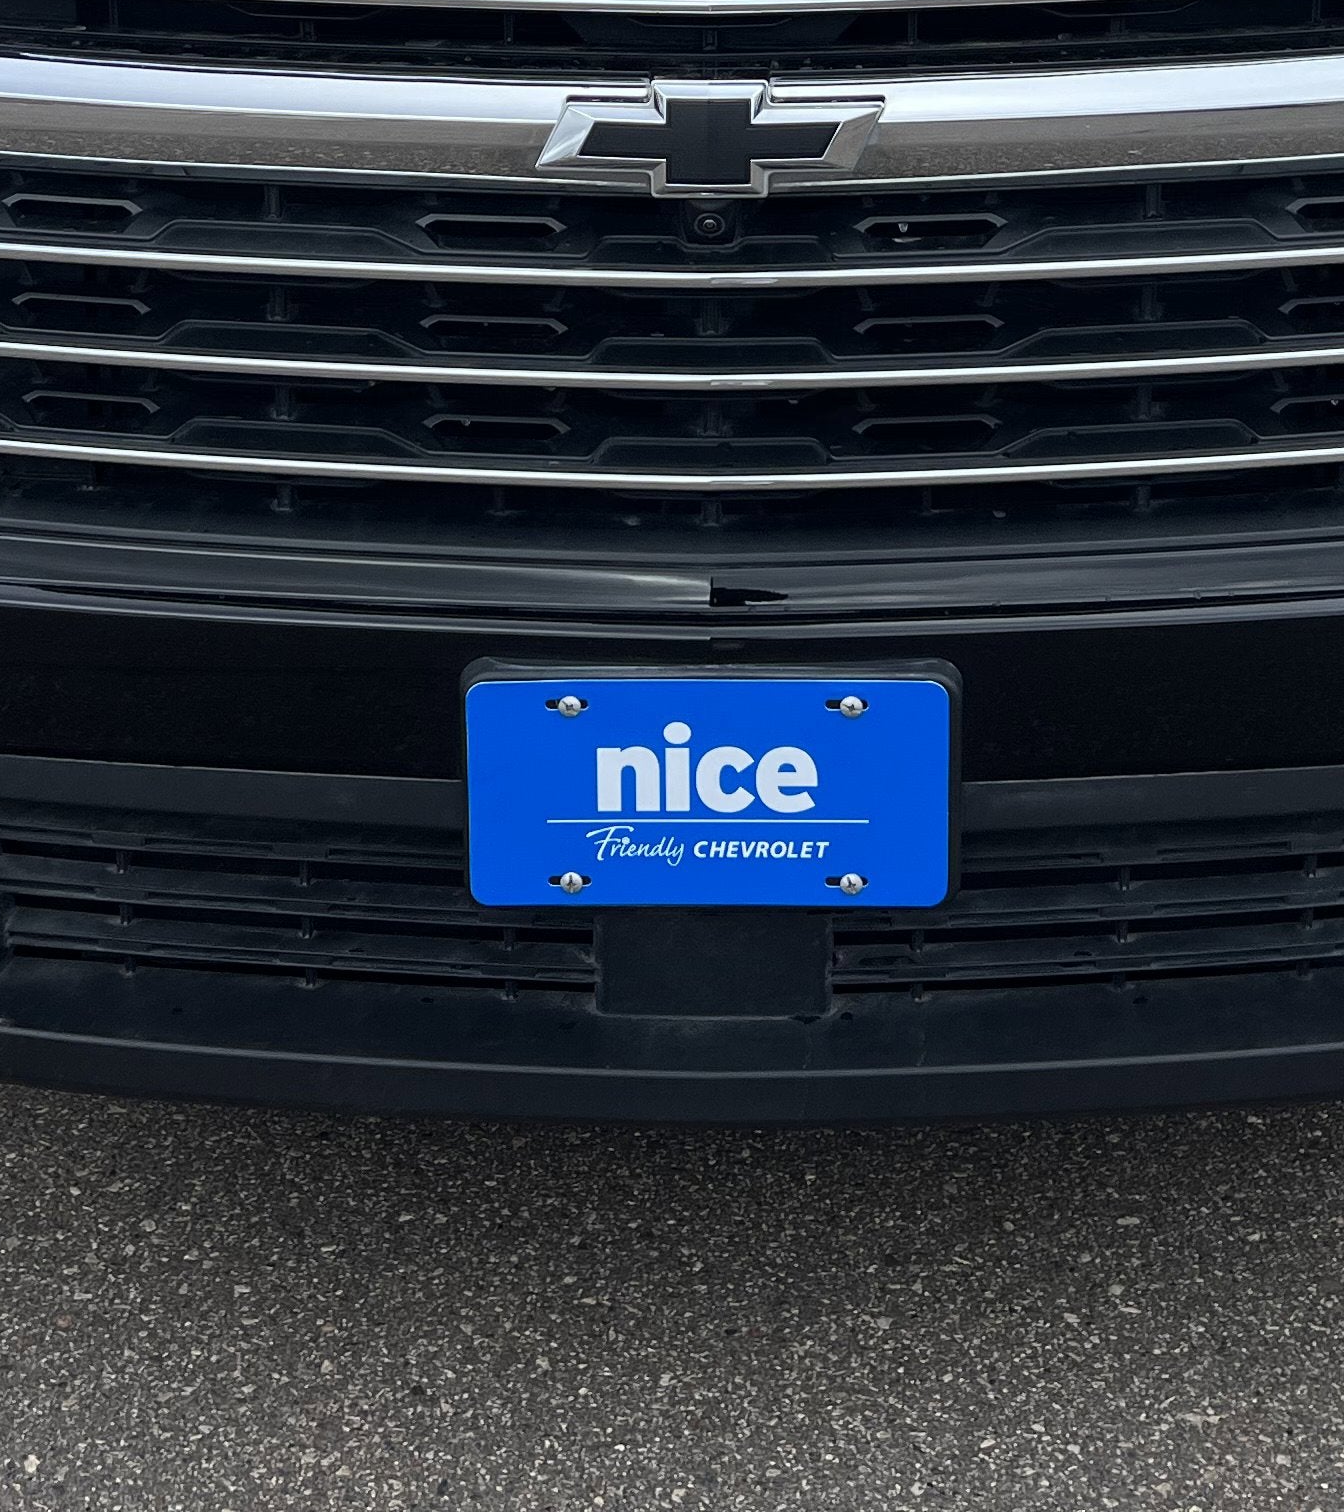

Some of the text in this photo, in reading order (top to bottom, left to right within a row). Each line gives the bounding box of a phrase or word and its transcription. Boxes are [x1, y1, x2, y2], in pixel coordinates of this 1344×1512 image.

[596, 721, 818, 813] nice
[585, 825, 830, 867] Friendly CHEVROLET
